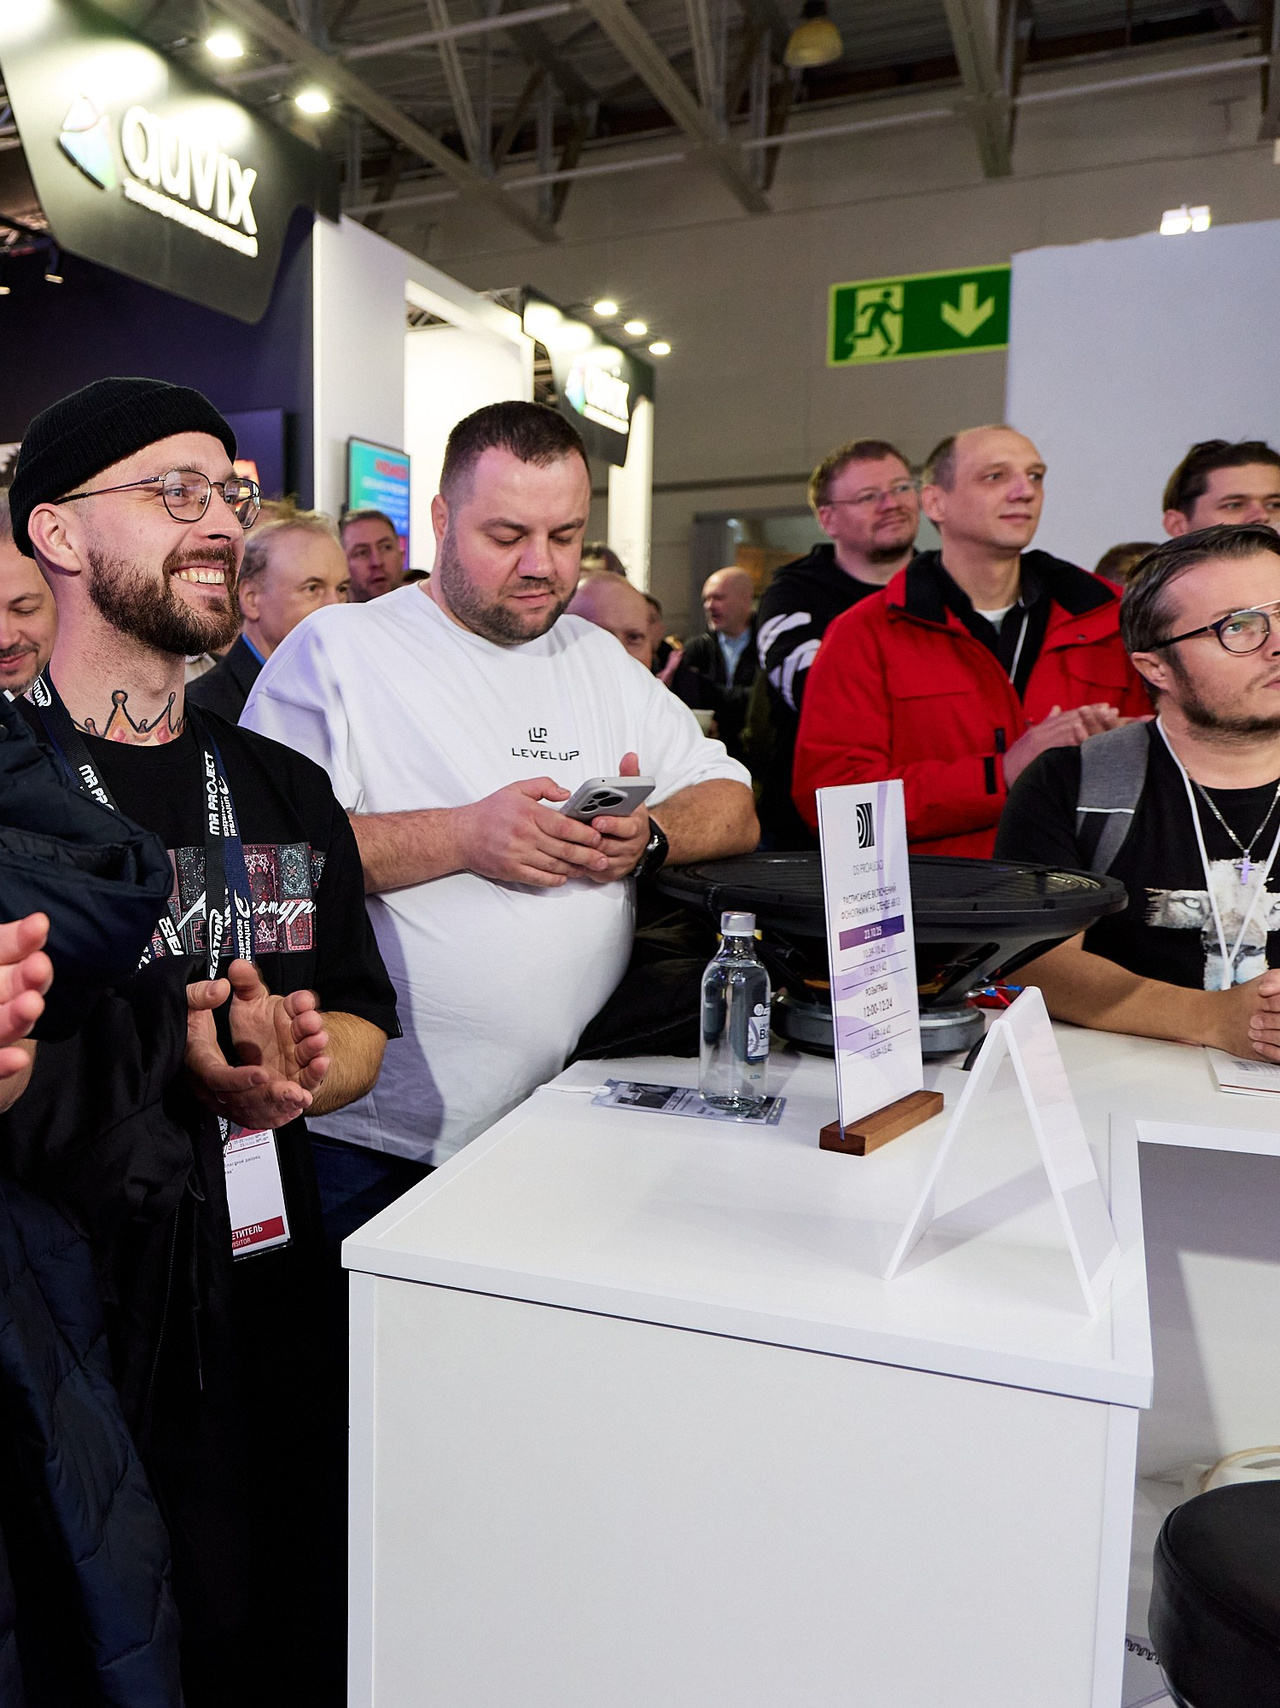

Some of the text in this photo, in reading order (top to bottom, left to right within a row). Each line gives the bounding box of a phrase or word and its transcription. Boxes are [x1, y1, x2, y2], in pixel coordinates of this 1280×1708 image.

[204, 750, 218, 811] PROJECT
[236, 918, 245, 959] acoustic
[243, 920, 253, 964] universa
[231, 1225, 263, 1241] ЕТИТЕЛЬ
